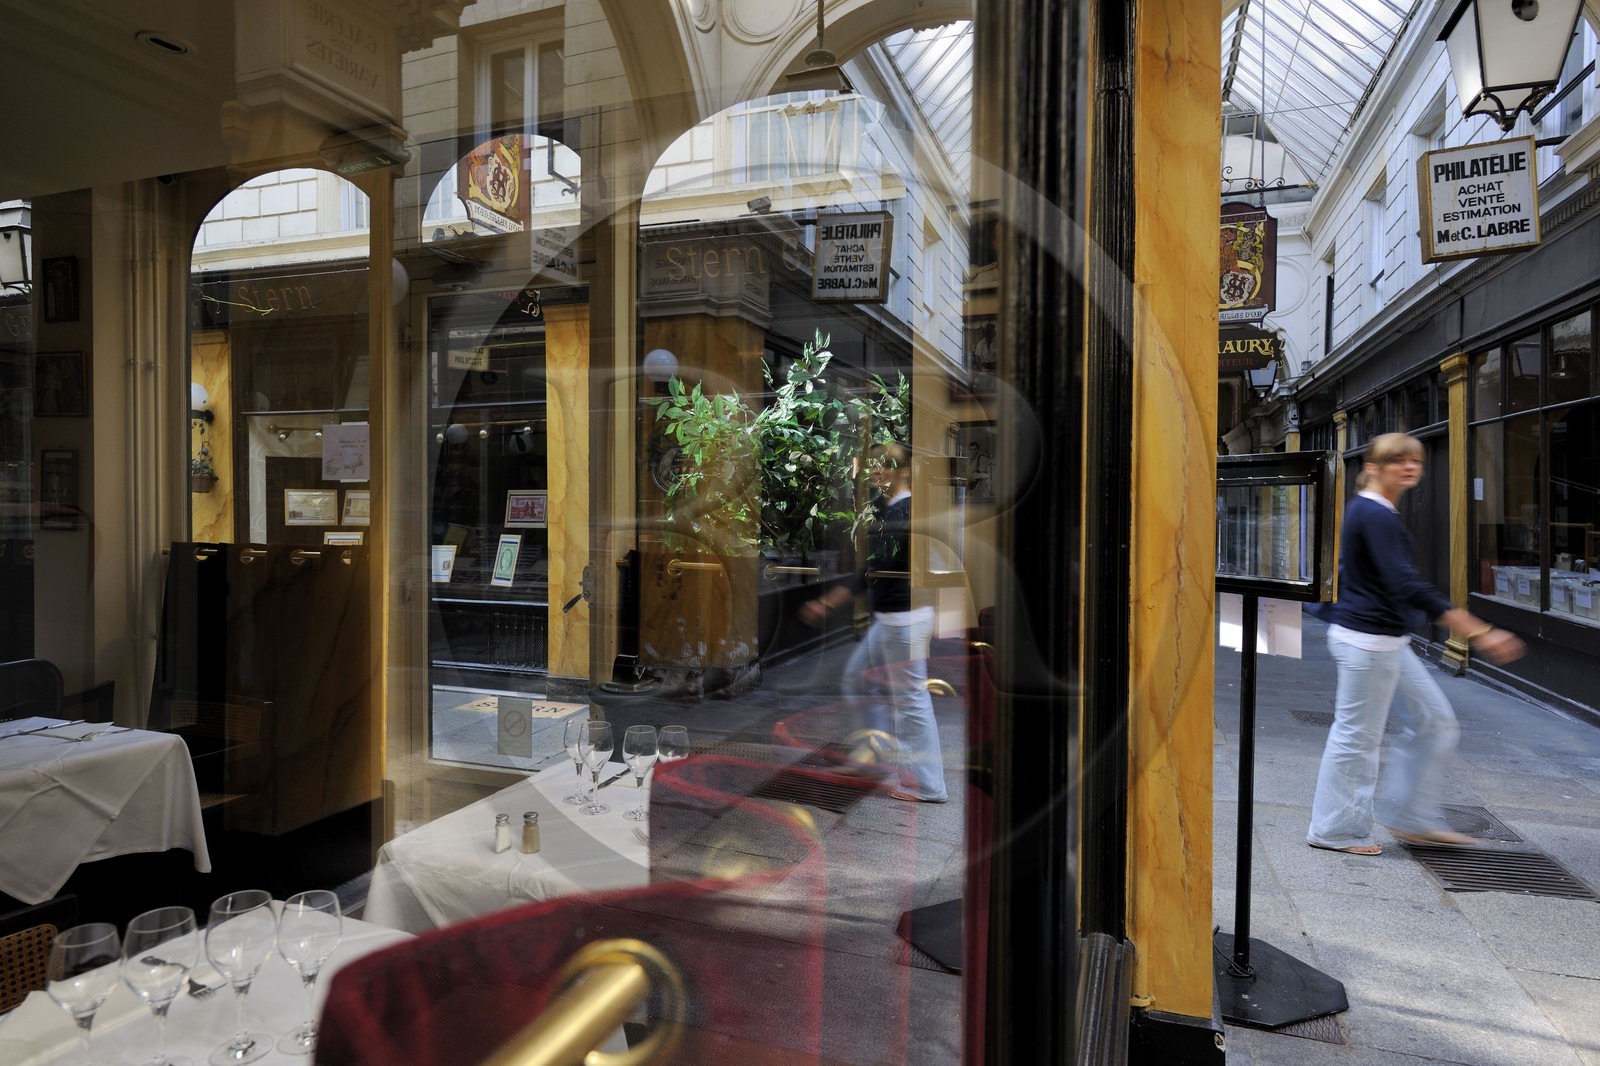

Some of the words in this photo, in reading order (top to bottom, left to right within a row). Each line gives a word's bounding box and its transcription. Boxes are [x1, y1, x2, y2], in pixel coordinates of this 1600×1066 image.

[1458, 181, 1504, 196] ACHAT
[1458, 193, 1505, 208] VENTE
[1443, 203, 1521, 222] ESTIMATION
[1477, 218, 1530, 239] LABRE
[666, 245, 766, 281] Stern
[238, 286, 316, 313] Stern
[475, 700, 567, 714] SRN
